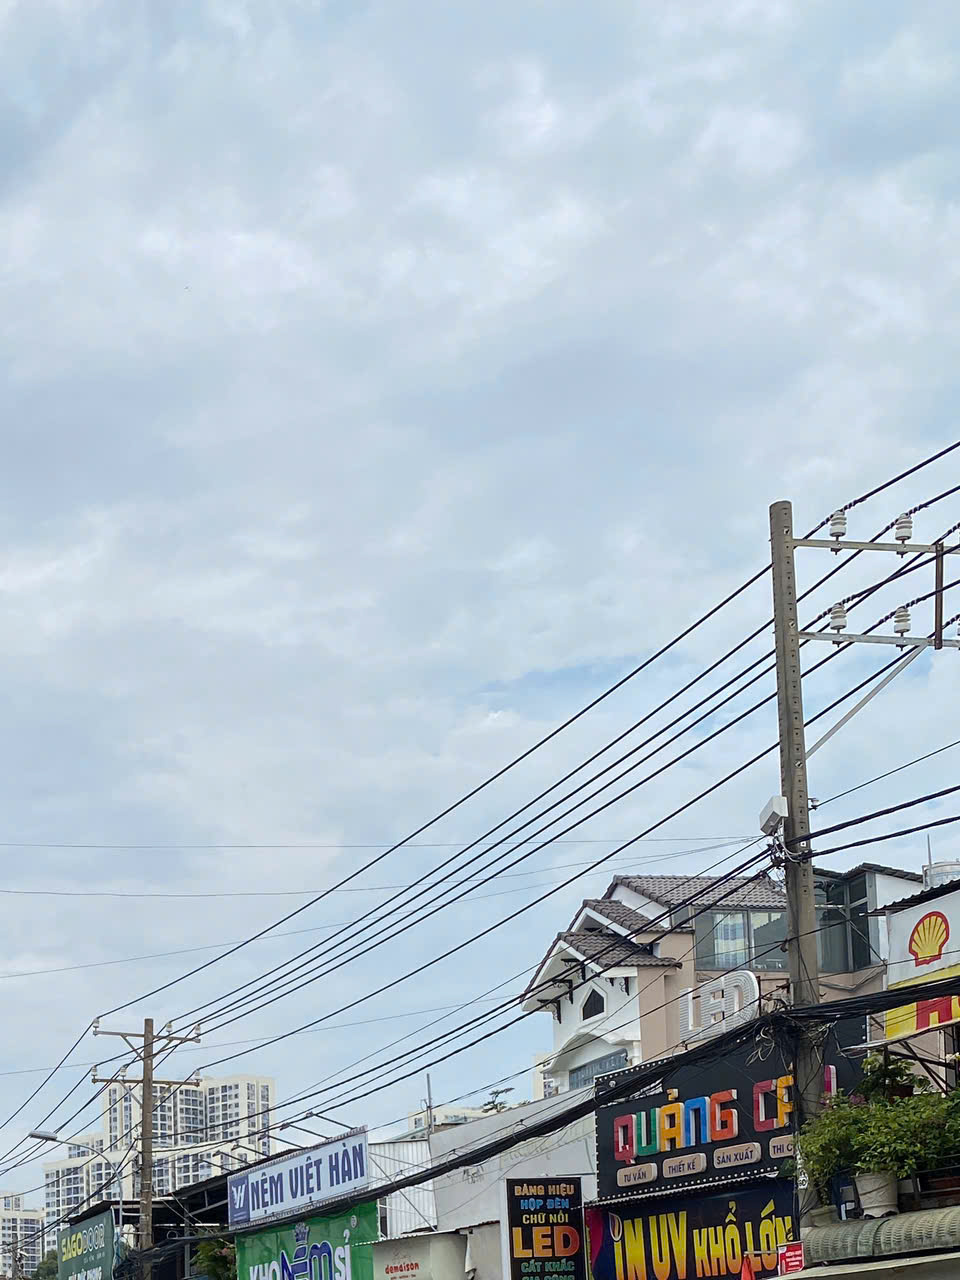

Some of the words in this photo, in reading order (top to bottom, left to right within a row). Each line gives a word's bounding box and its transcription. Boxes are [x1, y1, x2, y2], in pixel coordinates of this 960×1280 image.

[614, 1089, 738, 1165] QUẢNG
[668, 1160, 685, 1174] THIẾT
[734, 1147, 754, 1162] XUẤT
[772, 1143, 784, 1154] THI
[251, 1172, 284, 1215] NỆM
[289, 1156, 322, 1203] VIỆT
[328, 1143, 365, 1187] HÀN
[514, 1184, 544, 1196] BẢNG
[548, 1184, 575, 1196] HIỆU
[520, 1198, 543, 1211] HỘP
[546, 1197, 569, 1209] ĐÈN
[522, 1213, 546, 1224] CHỮ
[512, 1226, 580, 1258] LED
[649, 1210, 687, 1280] UV
[692, 1201, 741, 1278] KHỔ
